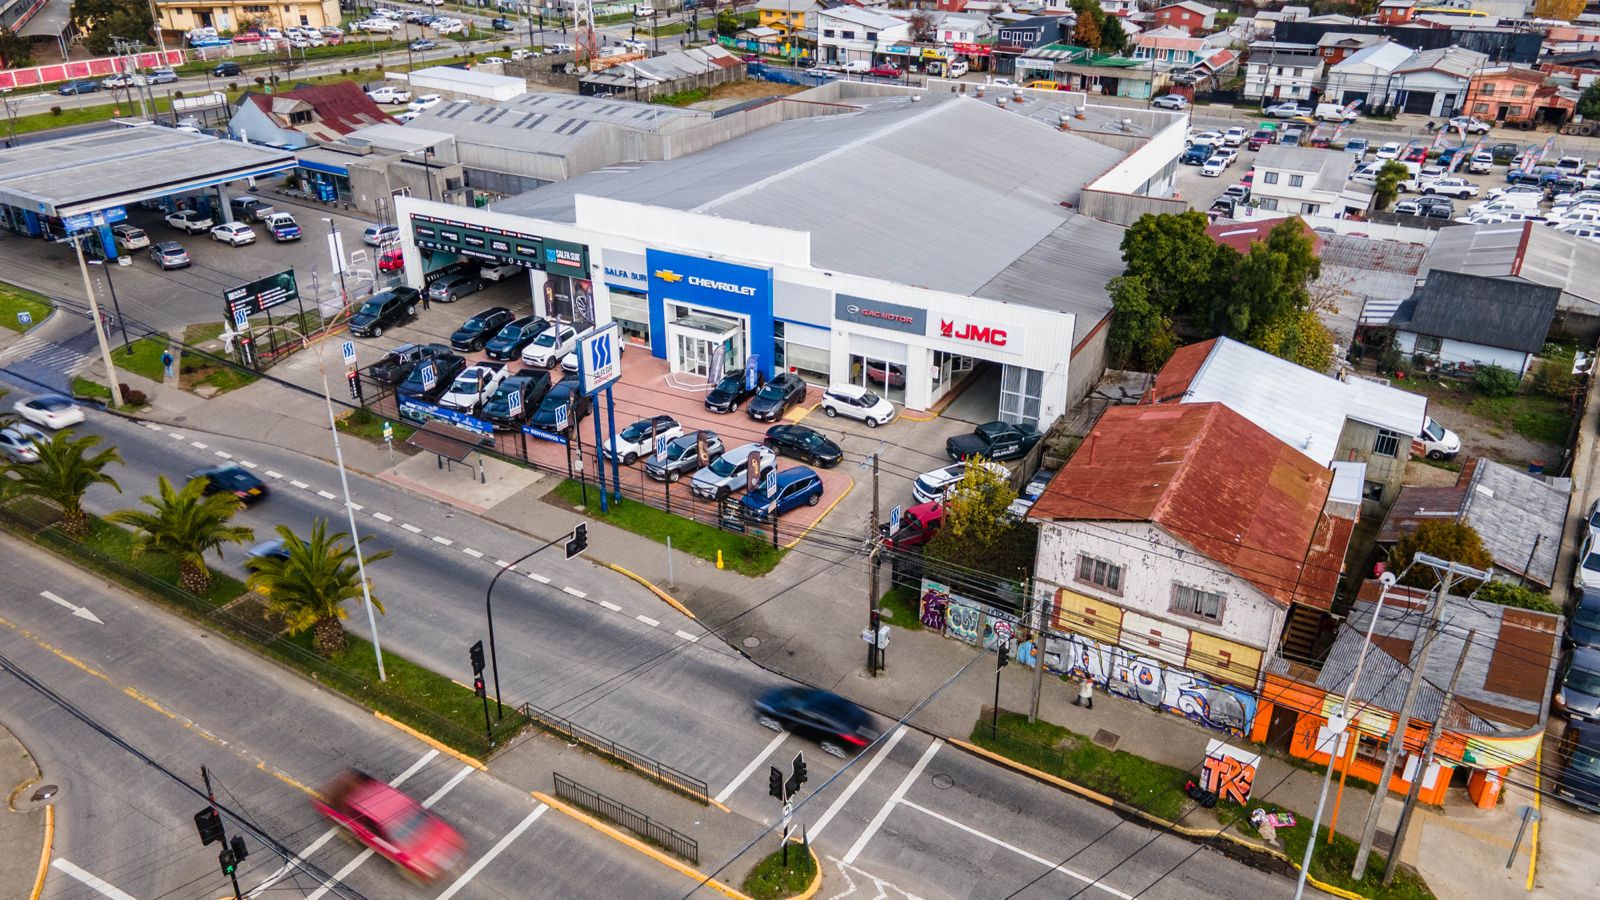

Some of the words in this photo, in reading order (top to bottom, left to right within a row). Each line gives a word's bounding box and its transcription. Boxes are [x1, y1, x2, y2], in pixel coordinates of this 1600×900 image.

[604, 267, 628, 279] SALFA
[630, 273, 647, 282] SUR
[688, 276, 757, 297] CHEVROLET
[861, 309, 881, 319] GAC
[881, 312, 913, 324] MOTOR
[955, 324, 1007, 346] JMC
